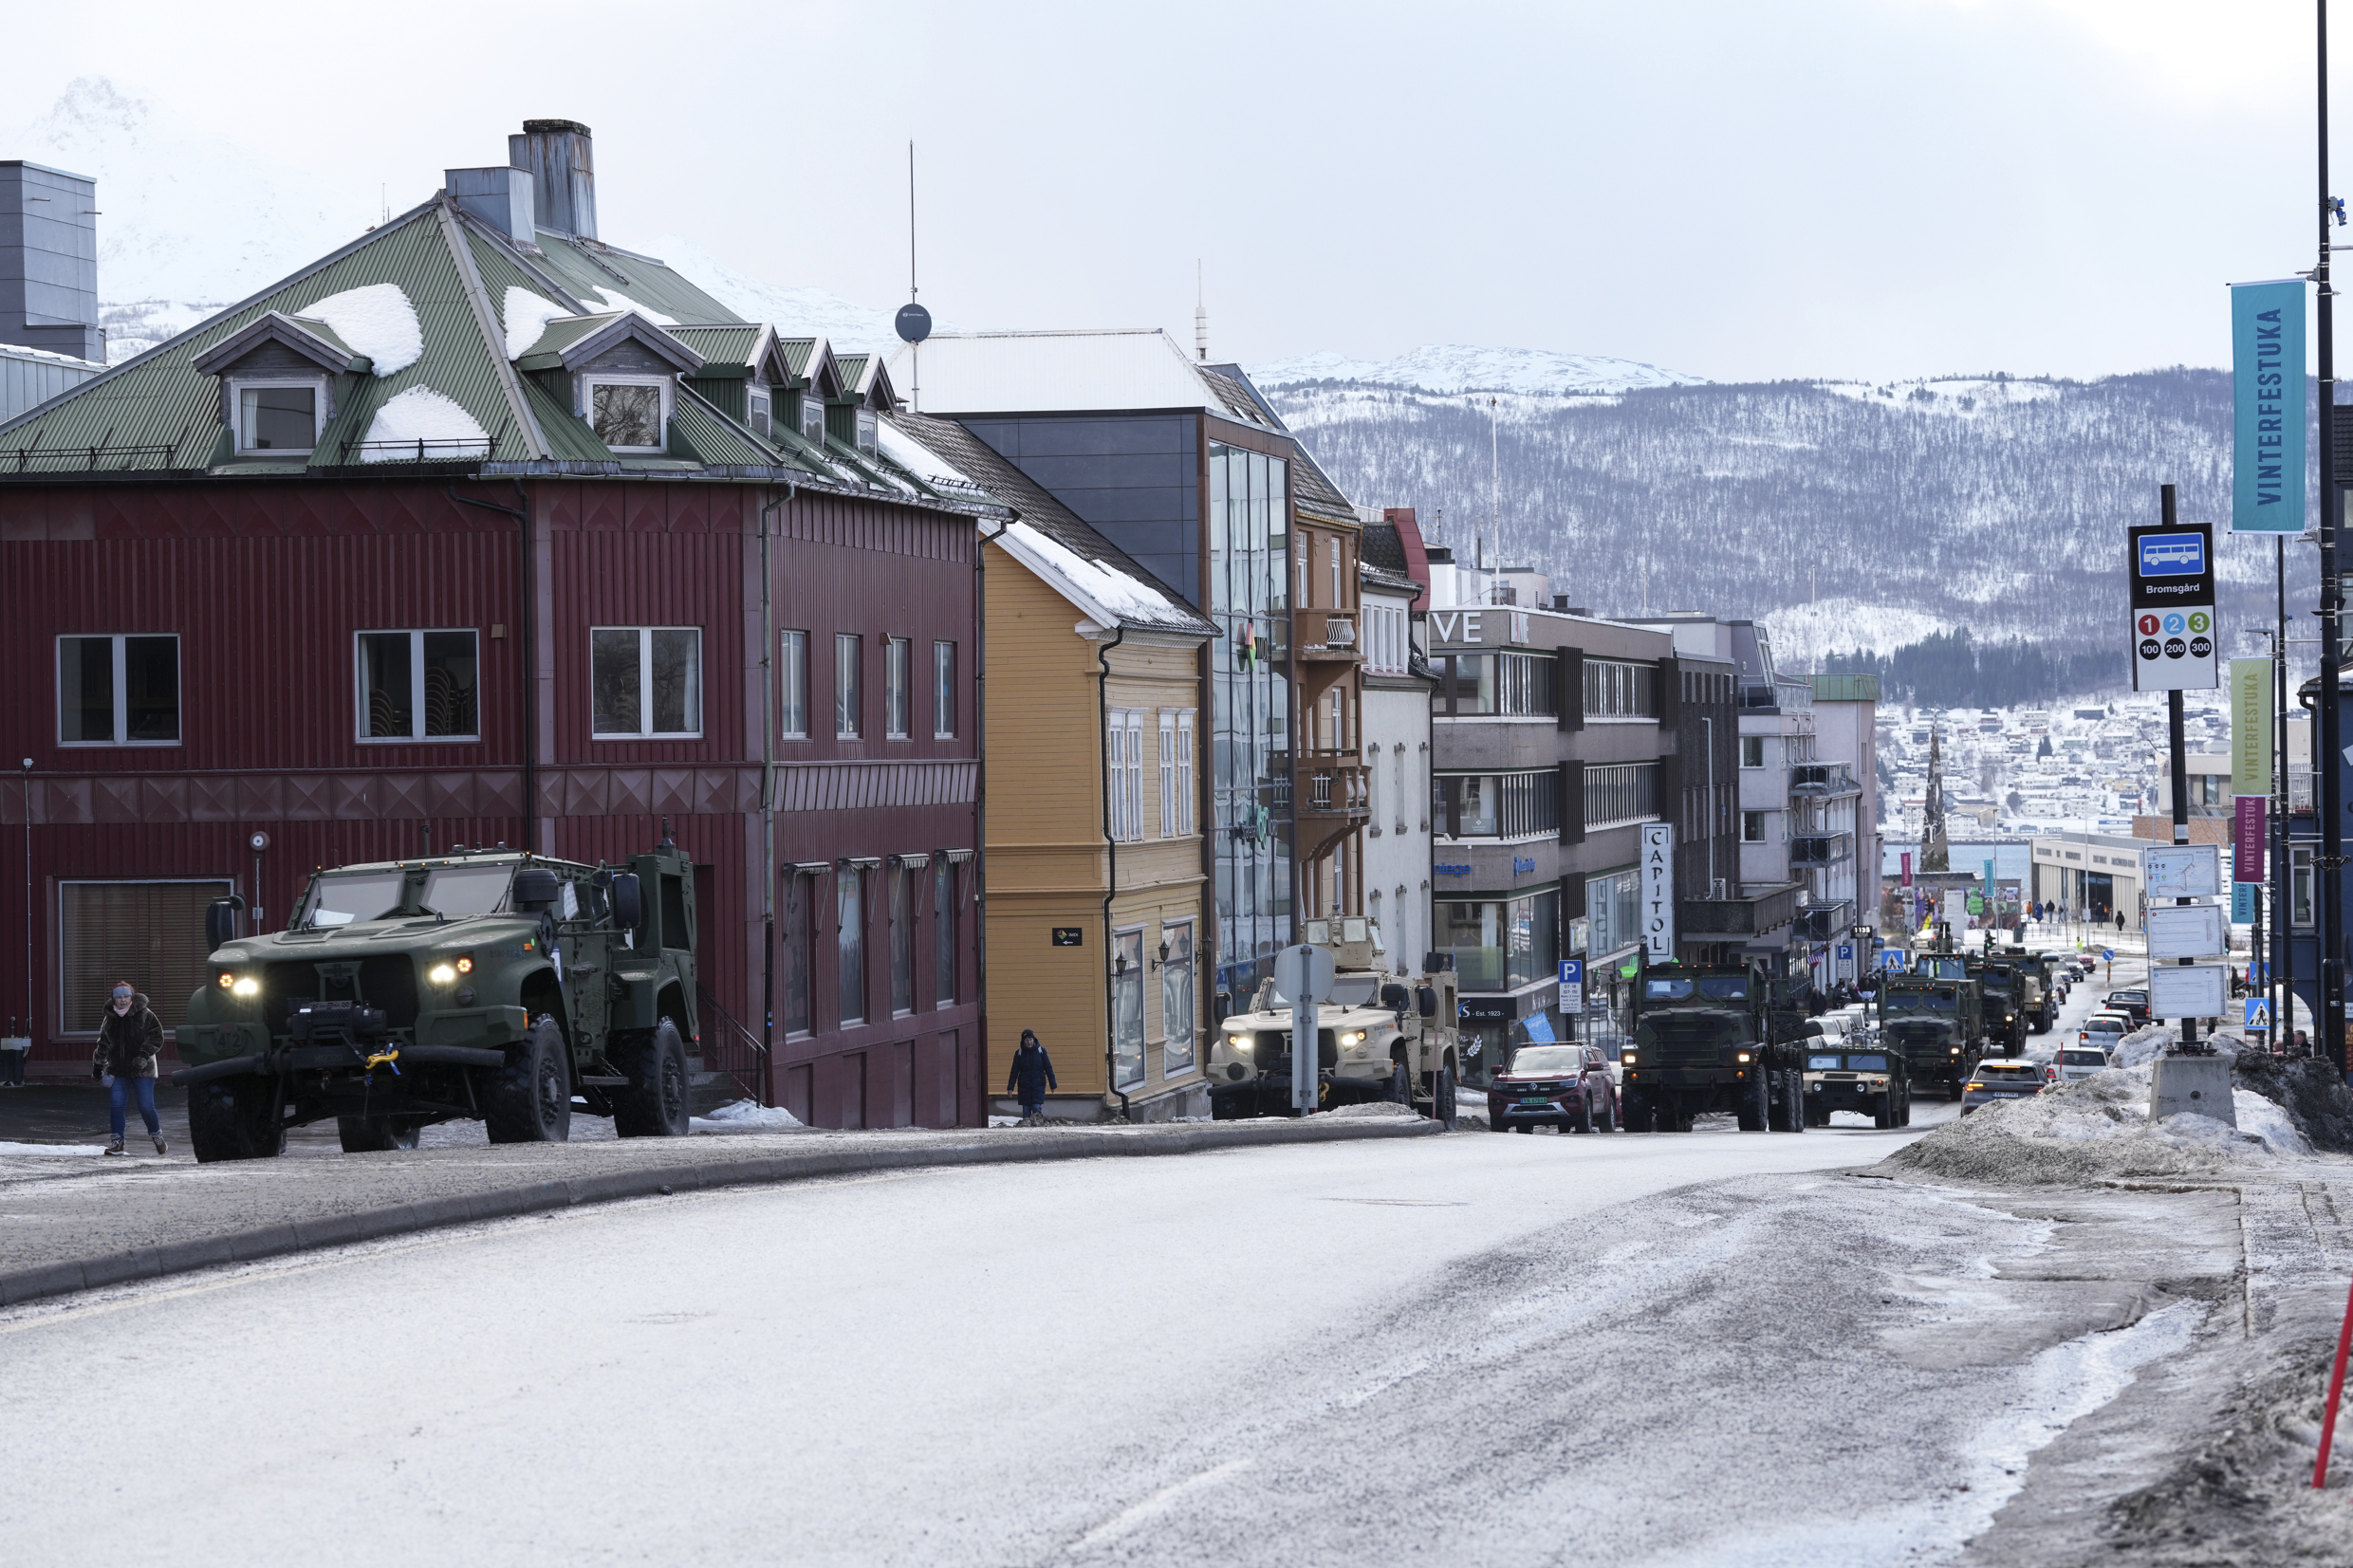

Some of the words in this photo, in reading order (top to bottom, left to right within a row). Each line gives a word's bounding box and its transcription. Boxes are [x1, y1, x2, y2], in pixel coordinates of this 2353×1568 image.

[2256, 308, 2282, 507] VINTERFESTUKA
[2146, 583, 2200, 595] Bromsgård
[2144, 618, 2153, 633] 1
[2169, 617, 2180, 632] 2
[2194, 615, 2205, 631] 3
[2141, 645, 2159, 655] 100
[2166, 644, 2185, 654] 200
[2191, 642, 2211, 653] 300
[2244, 673, 2259, 782] VINTERFESTUKA
[2244, 796, 2256, 873] VINTERFESTUK
[1434, 861, 1472, 877] nlege
[1650, 831, 1664, 950] CAPITOL
[2238, 883, 2248, 916] VINTERF
[1841, 947, 1849, 958] P
[1564, 963, 1576, 981] P
